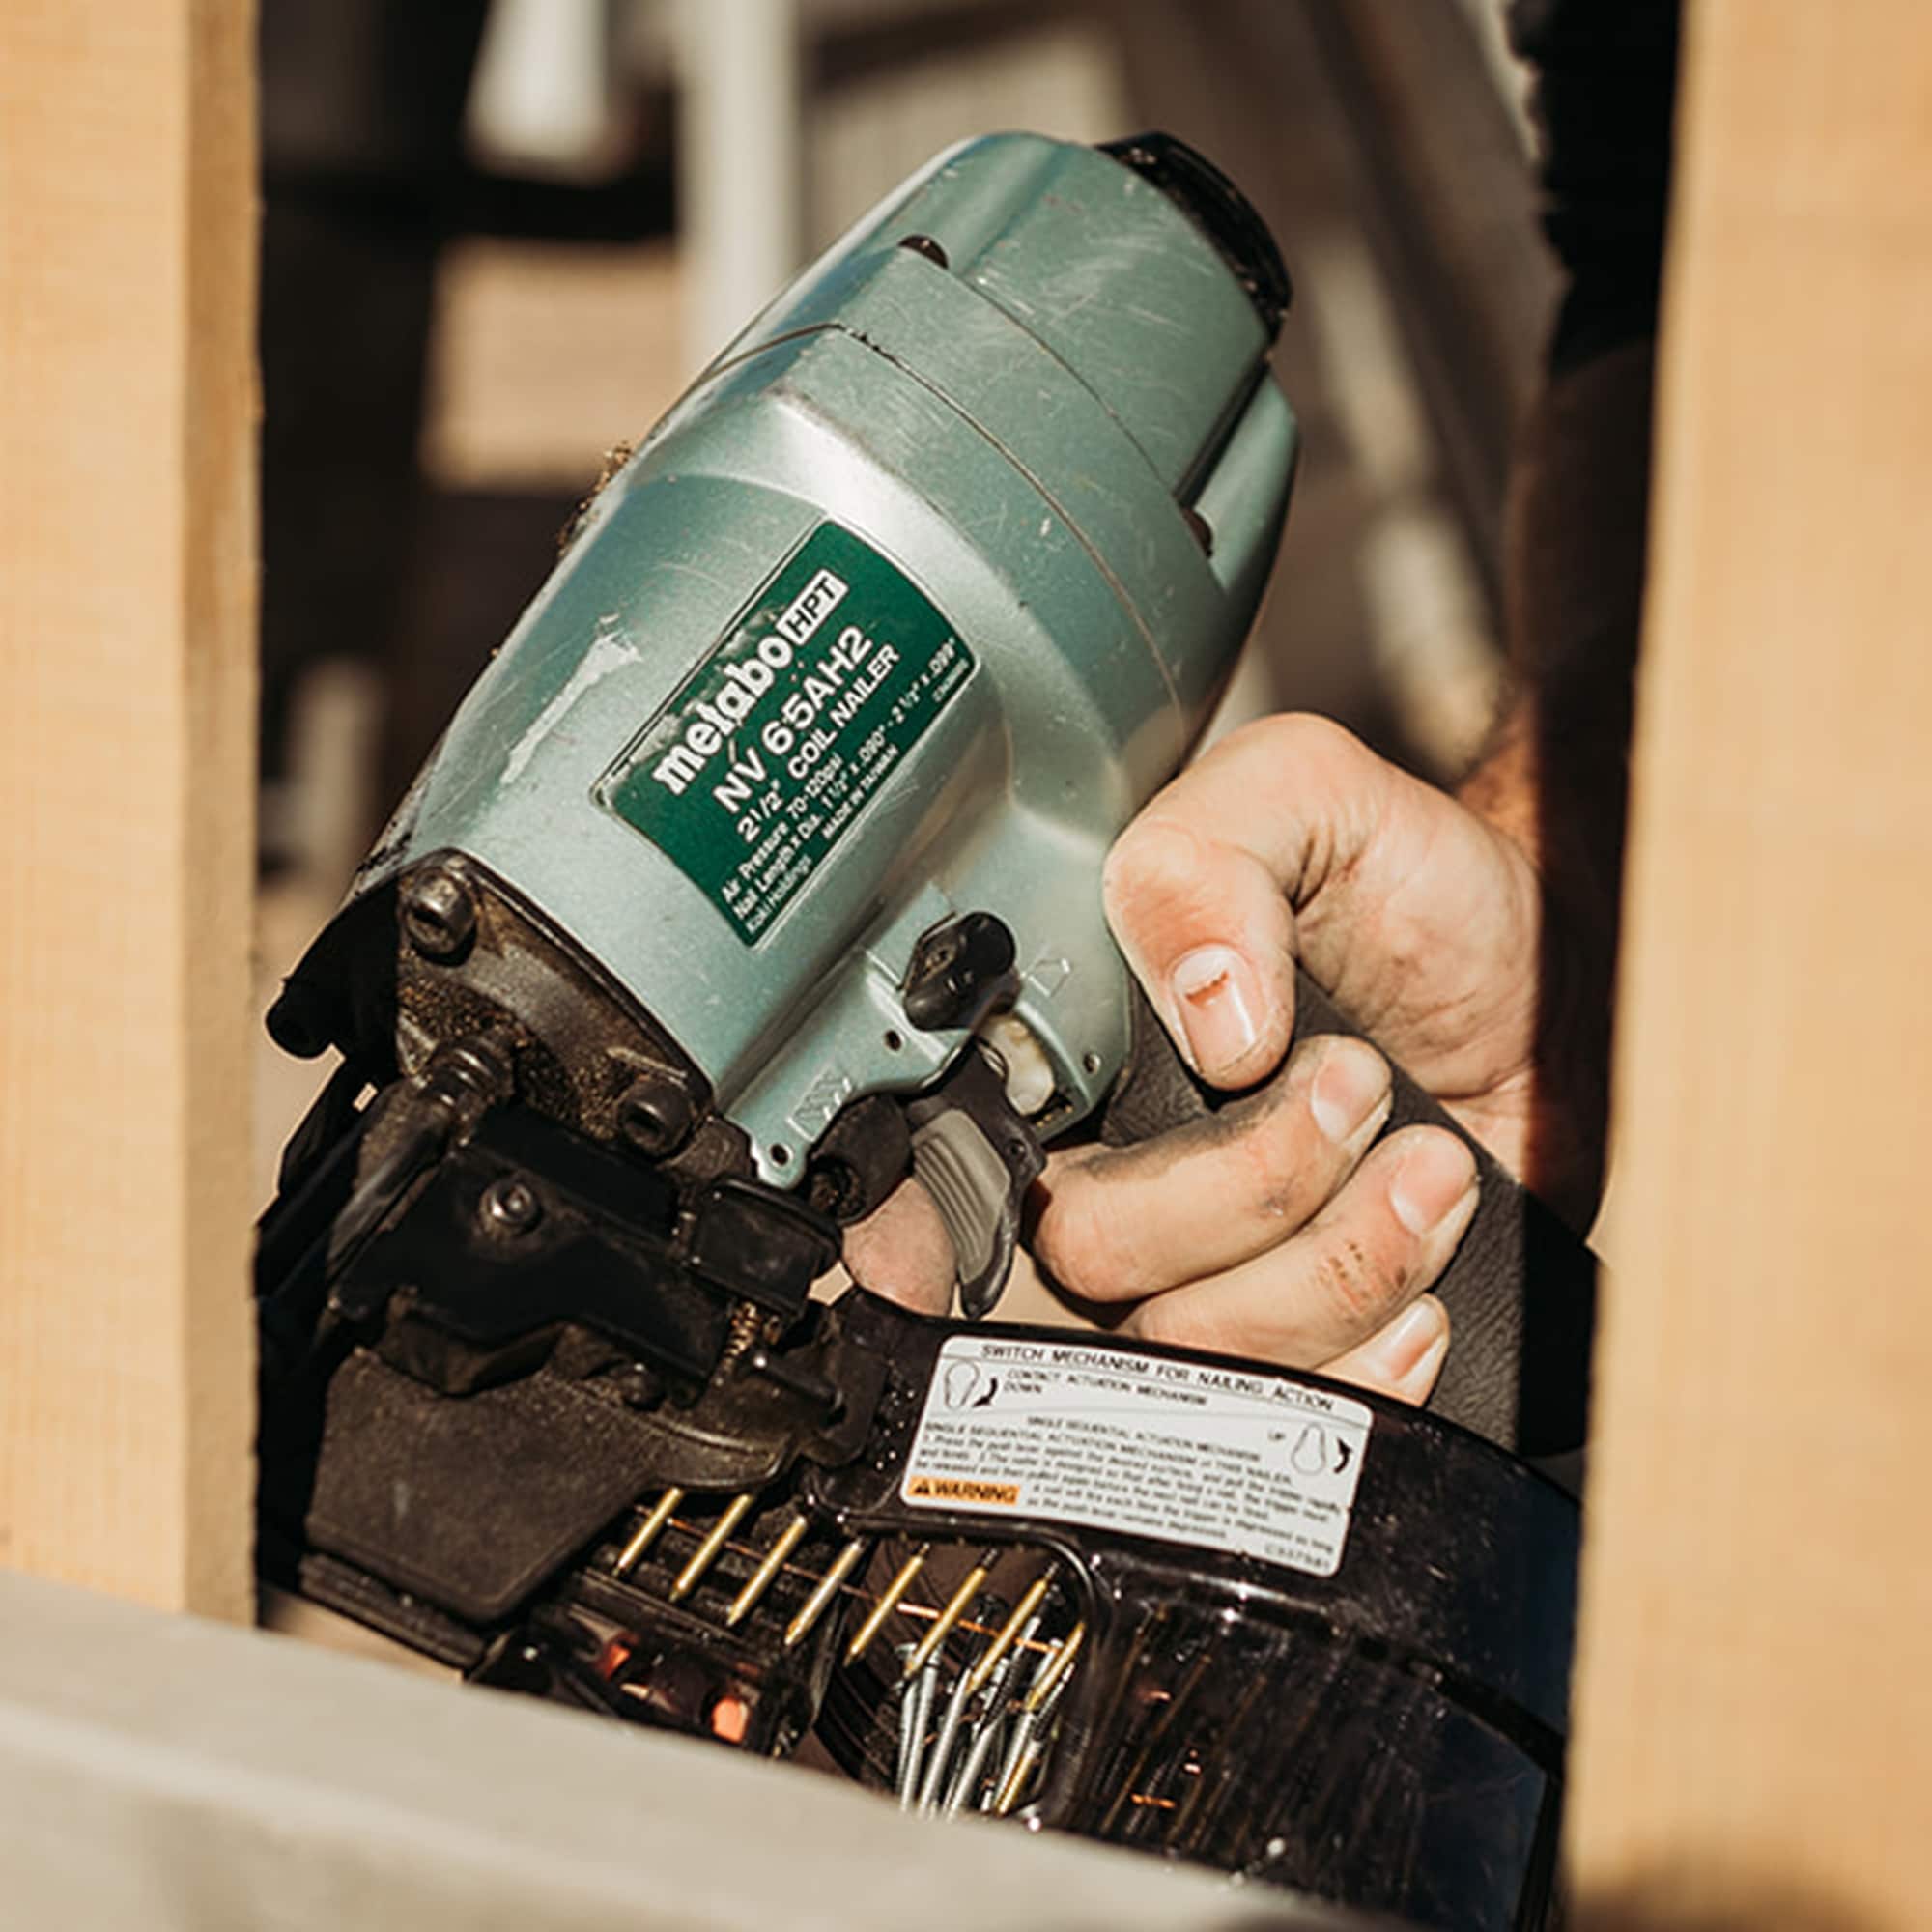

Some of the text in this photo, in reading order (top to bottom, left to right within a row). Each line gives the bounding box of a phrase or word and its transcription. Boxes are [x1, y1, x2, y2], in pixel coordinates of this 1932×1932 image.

[652, 577, 834, 795] metabo HPT
[712, 626, 872, 813] NV 65AH2
[786, 727, 838, 779] COIL
[829, 643, 899, 728] NAILER
[821, 800, 853, 838] MADE
[848, 786, 864, 805] IN
[721, 878, 741, 903] Air
[737, 821, 788, 880] Pressure
[732, 887, 758, 919] Nail
[753, 844, 795, 893] Length
[981, 1344, 1334, 1411] SWITCH MECHANISM FOR NAILING ACTION
[934, 1481, 1017, 1504] WARNING
